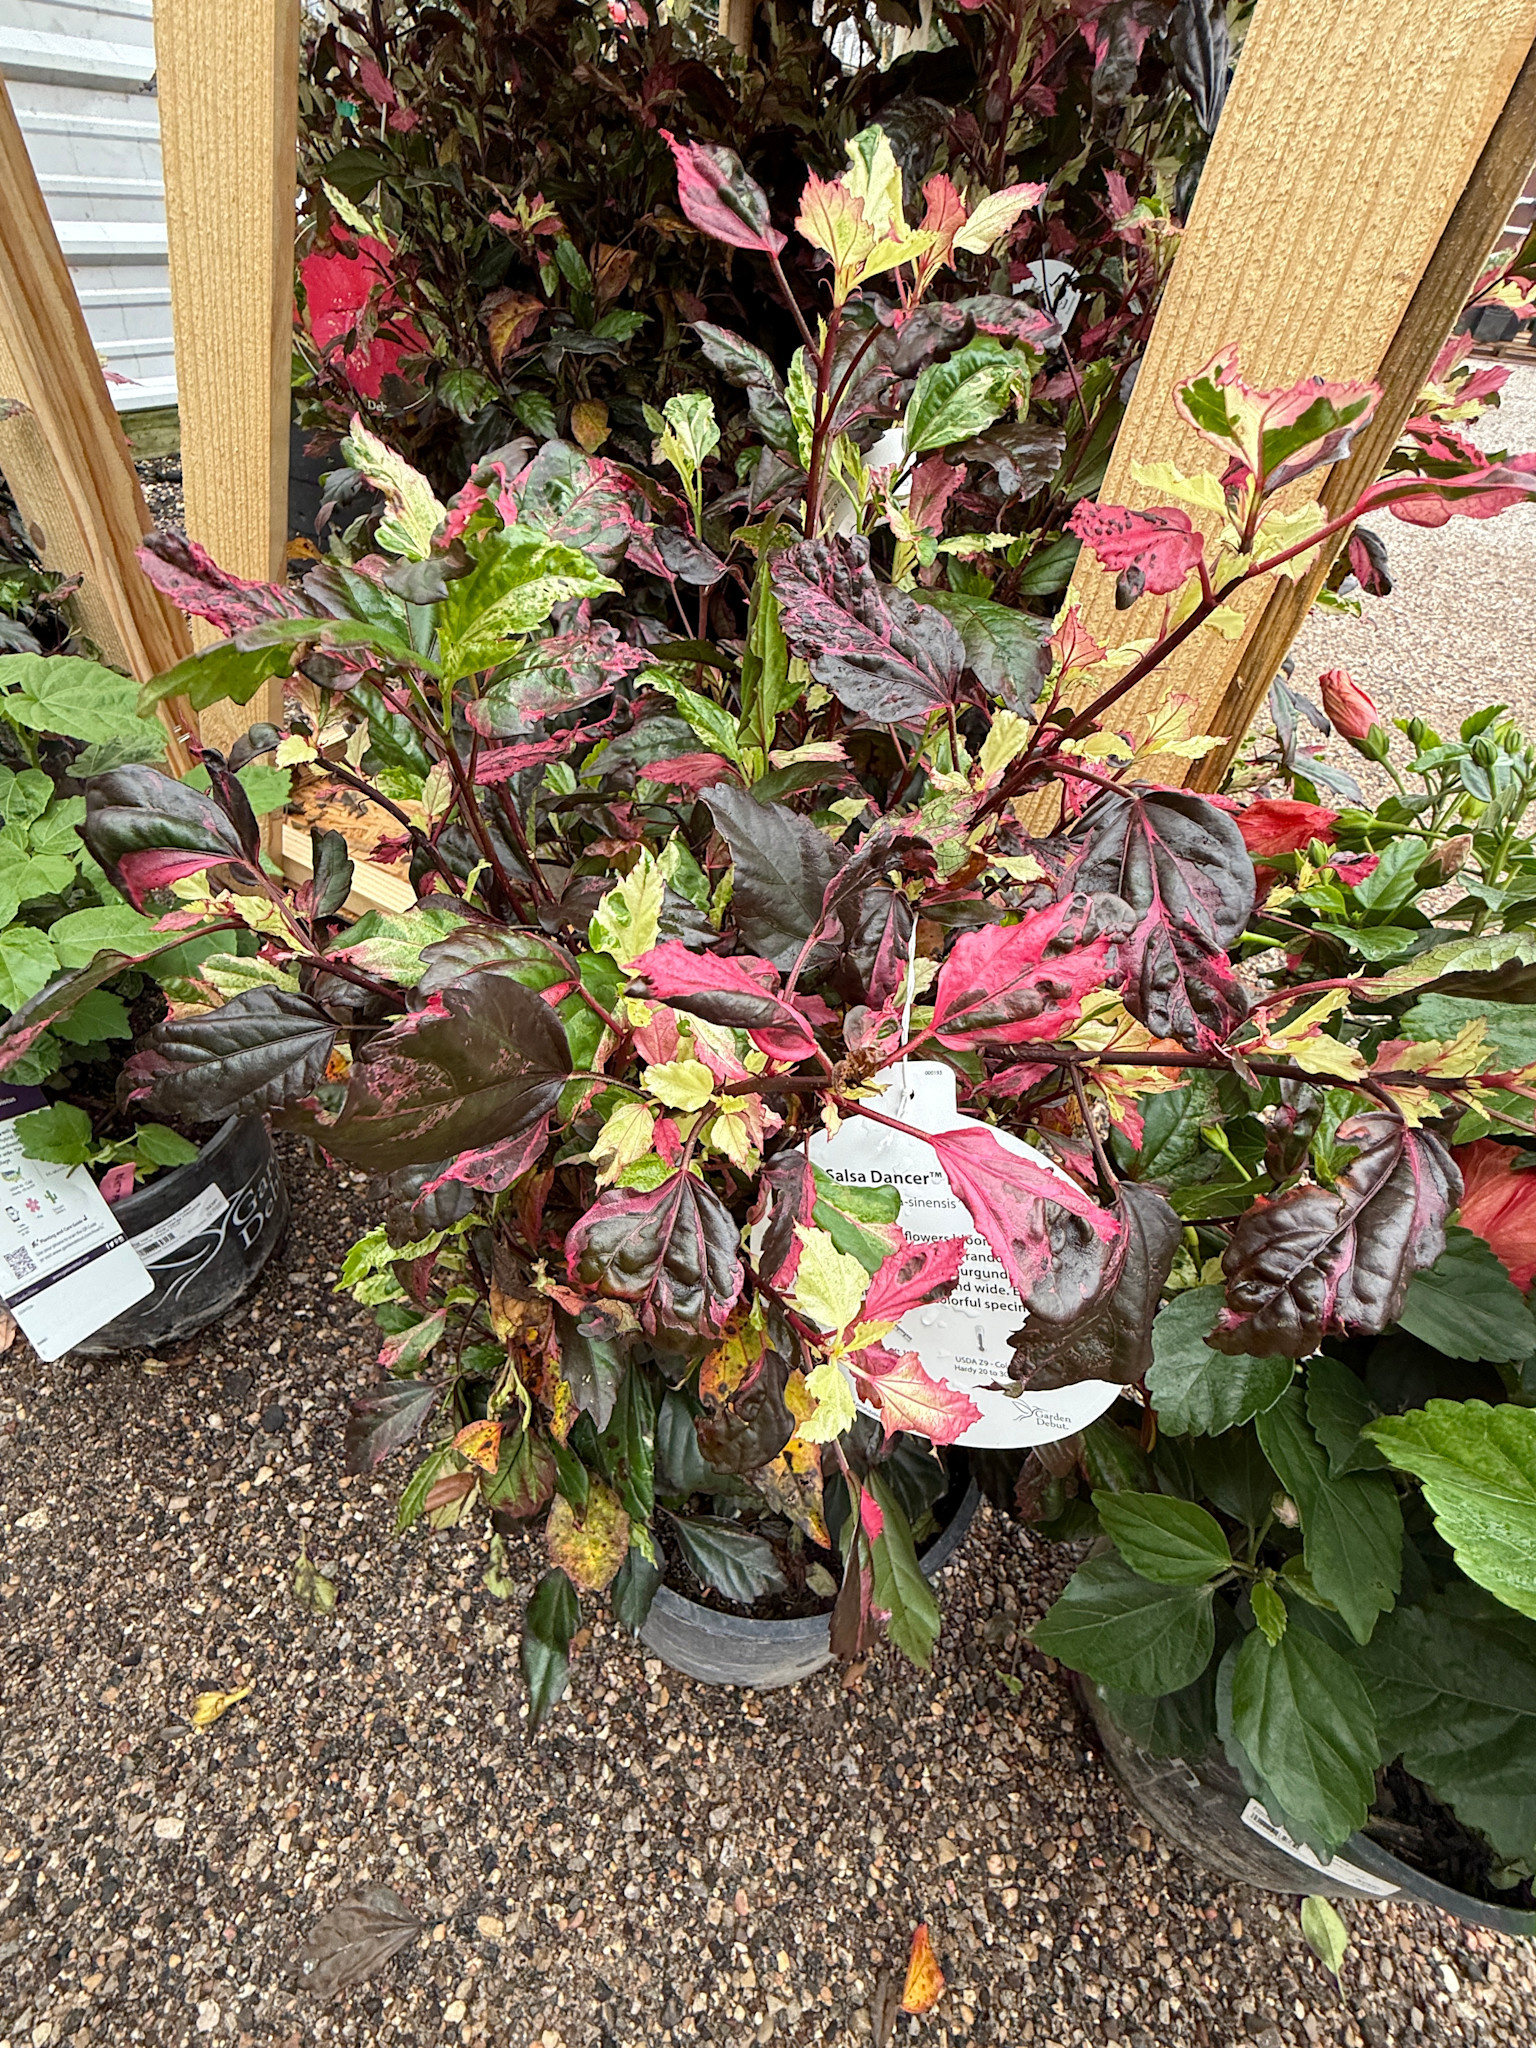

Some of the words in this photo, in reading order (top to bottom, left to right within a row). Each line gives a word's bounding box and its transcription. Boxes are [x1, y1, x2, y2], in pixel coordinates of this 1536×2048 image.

[825, 1168, 867, 1183] Salsa
[870, 1169, 943, 1185] Dancer™
[974, 1283, 1010, 1296] wide.
[937, 1296, 982, 1309] olorful
[955, 1355, 978, 1365] USDA
[954, 1364, 977, 1375] Hardy
[978, 1367, 988, 1375] 20
[989, 1369, 998, 1377] to
[1035, 1410, 1072, 1424] Garden
